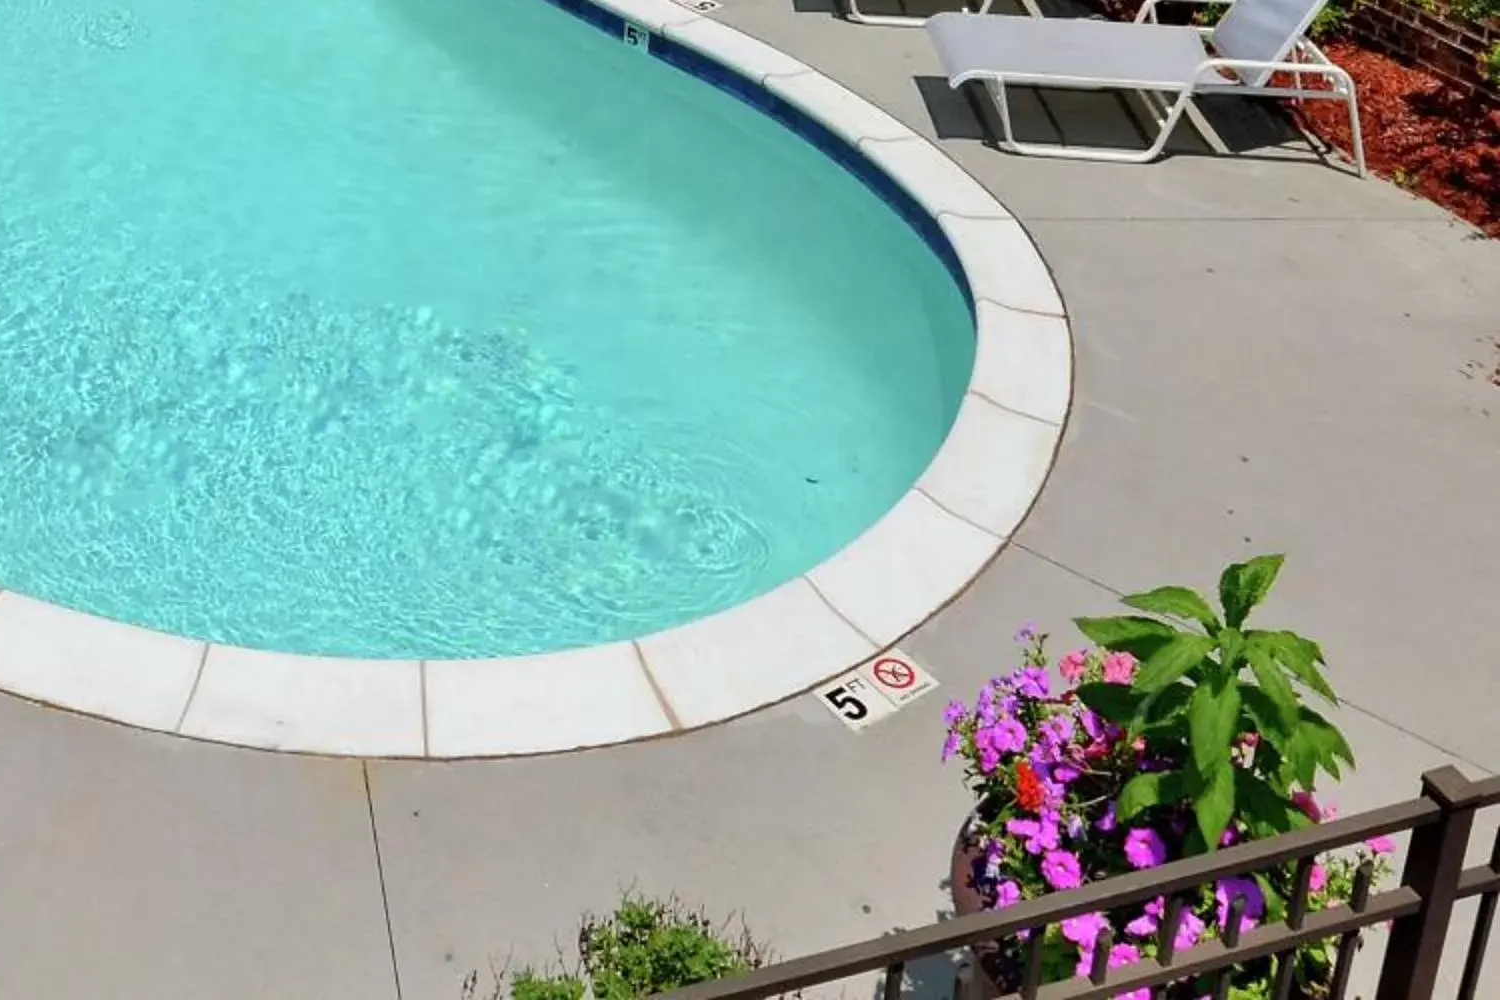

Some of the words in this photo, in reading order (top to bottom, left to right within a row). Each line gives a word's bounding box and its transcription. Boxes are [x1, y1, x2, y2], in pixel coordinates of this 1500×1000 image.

[627, 26, 639, 46] 5
[846, 678, 866, 692] FT
[825, 687, 868, 721] 5
